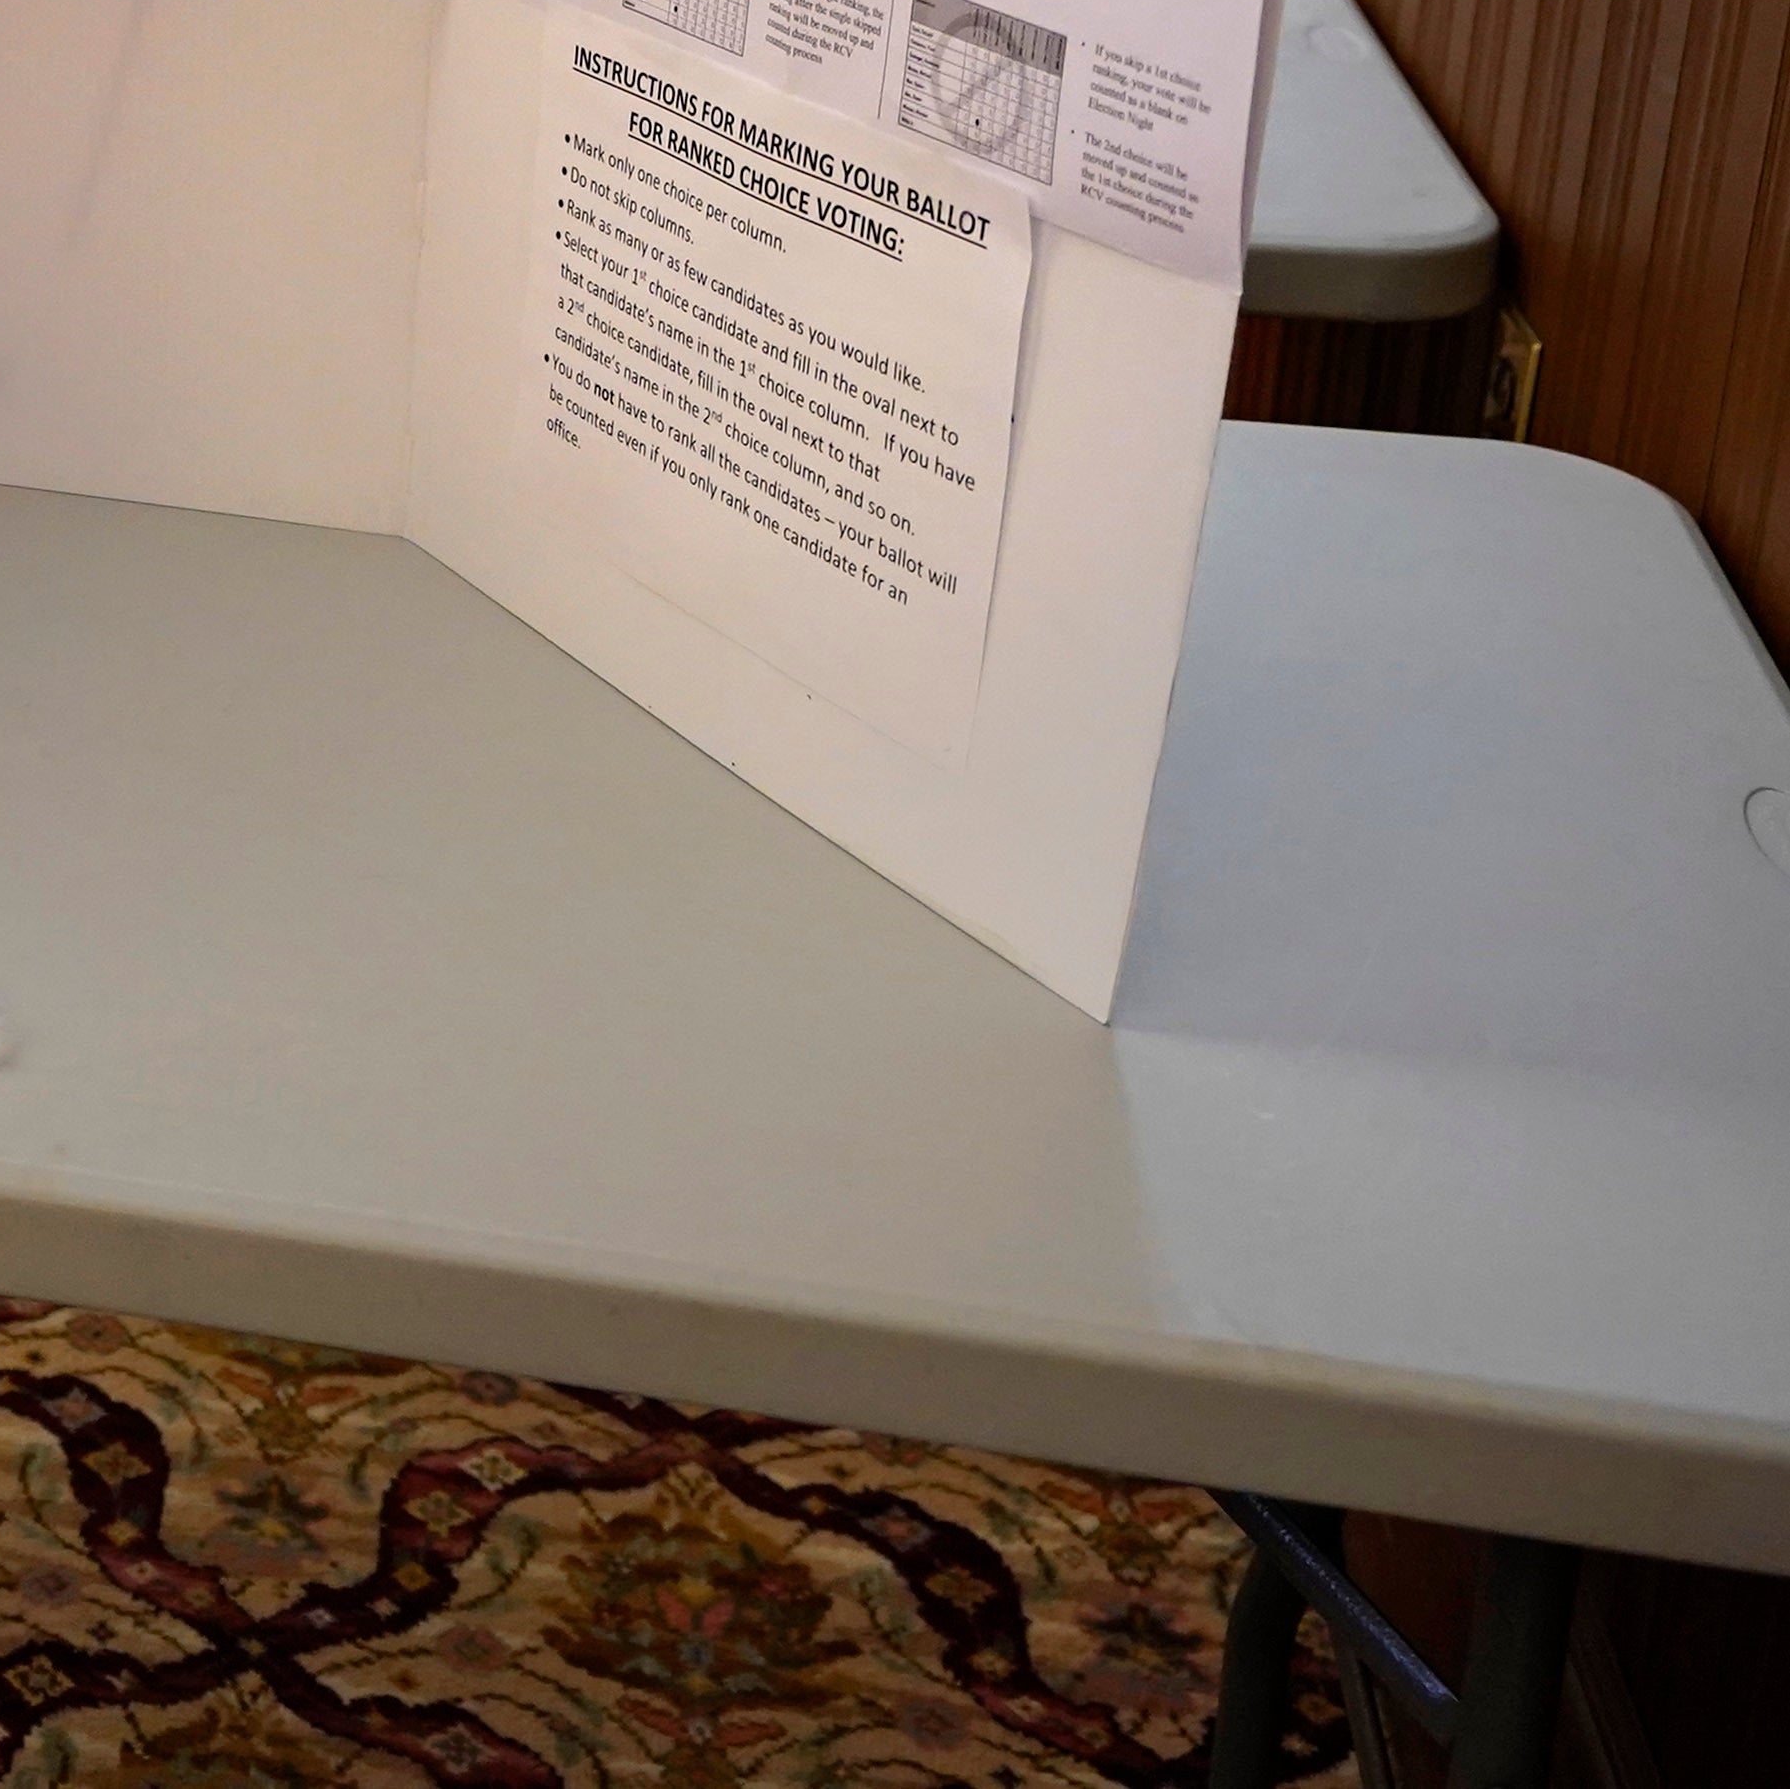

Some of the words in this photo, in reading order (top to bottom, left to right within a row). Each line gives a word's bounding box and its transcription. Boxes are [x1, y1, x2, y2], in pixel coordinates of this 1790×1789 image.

[570, 166, 587, 187] Do
[589, 179, 610, 200] not
[612, 189, 637, 216] skip
[639, 205, 693, 244] columns.
[573, 133, 605, 162] Mark
[607, 154, 635, 179] only
[637, 168, 660, 190] one
[663, 179, 703, 212] choice
[705, 203, 727, 223] per
[730, 216, 786, 253] column.
[574, 44, 697, 116] INSTRUCTIONS
[701, 100, 734, 135] FOR
[738, 118, 834, 177] MARKING
[841, 159, 899, 205] YOUR
[906, 187, 990, 240] BALLOT
[629, 111, 663, 145] FOR
[667, 128, 734, 178] RANKED
[739, 165, 810, 213] CHOICE
[816, 197, 904, 254] VOTING:
[566, 198, 596, 227] Rank
[598, 219, 611, 235] as
[614, 227, 648, 257] many
[650, 246, 664, 262] or
[666, 255, 680, 272] as
[683, 259, 707, 286] few
[710, 278, 784, 325] candidates
[788, 317, 803, 335] as
[808, 326, 836, 350] you
[840, 341, 889, 375] would
[893, 361, 924, 393] like.
